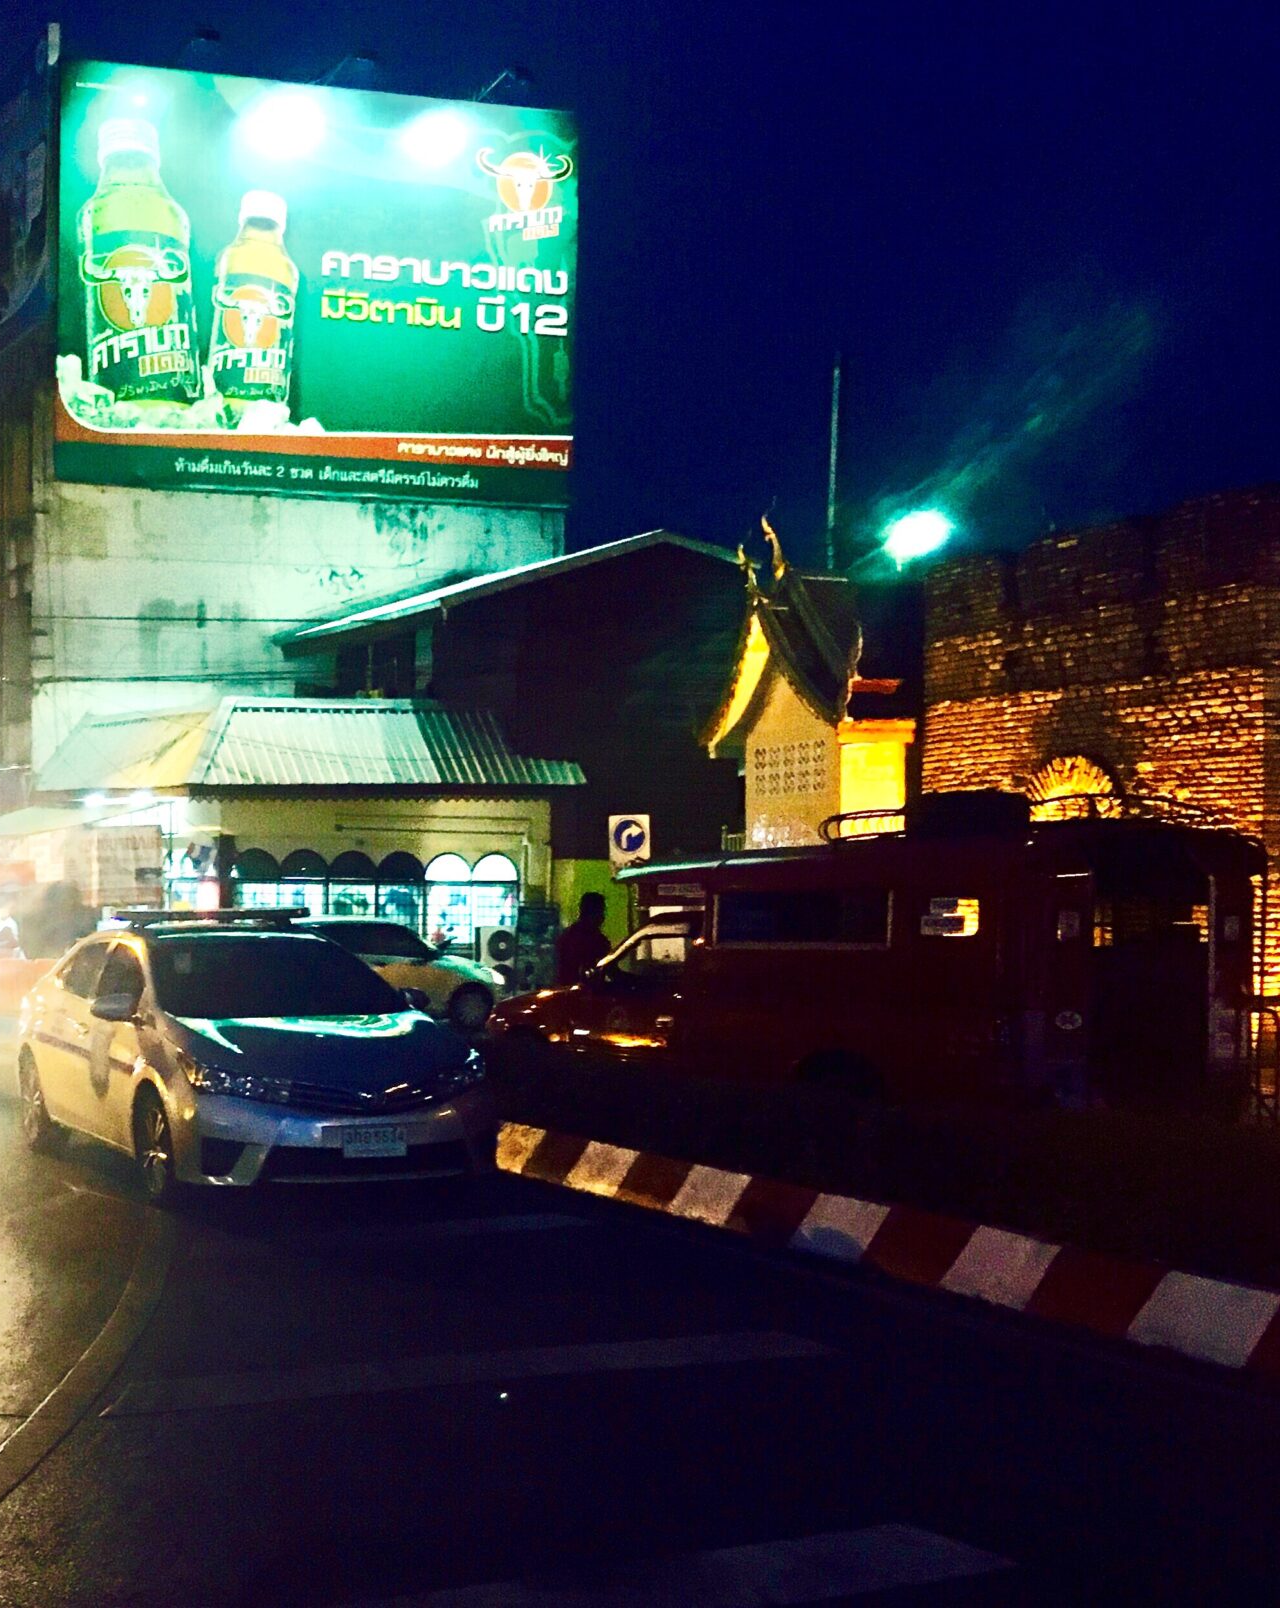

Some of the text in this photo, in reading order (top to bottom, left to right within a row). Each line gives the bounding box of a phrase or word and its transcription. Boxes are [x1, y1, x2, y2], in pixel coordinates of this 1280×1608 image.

[320, 251, 569, 295] คาราบาวแดง
[321, 289, 462, 329] มีวิตามิน
[276, 466, 285, 478] 2
